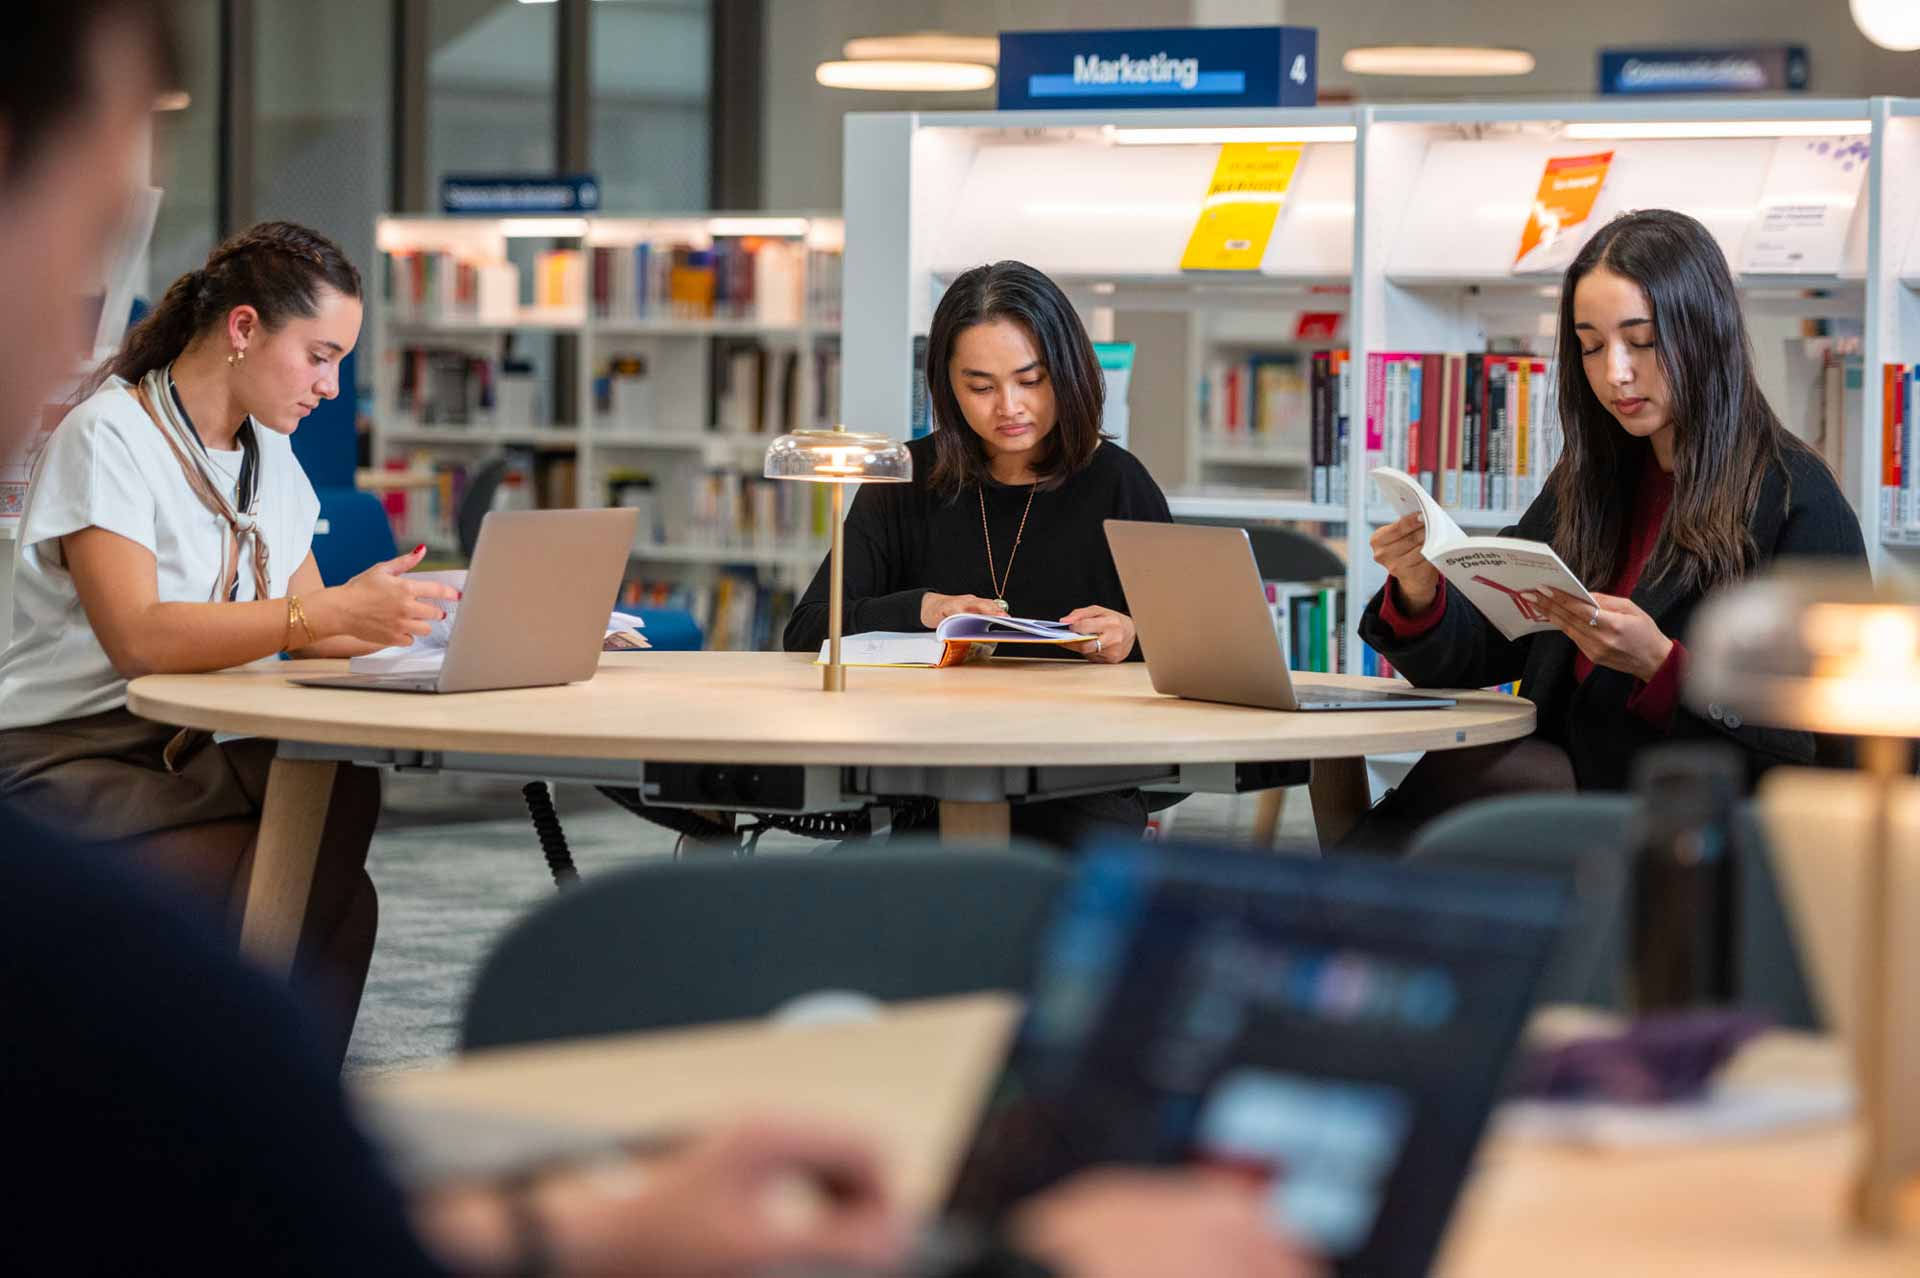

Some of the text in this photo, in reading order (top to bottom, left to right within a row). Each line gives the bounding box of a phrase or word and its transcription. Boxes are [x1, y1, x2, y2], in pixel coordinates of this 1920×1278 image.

[1074, 52, 1199, 89] Marketing
[1289, 54, 1308, 85] 4
[1446, 552, 1501, 566] Swedish
[1460, 559, 1507, 568] Design
